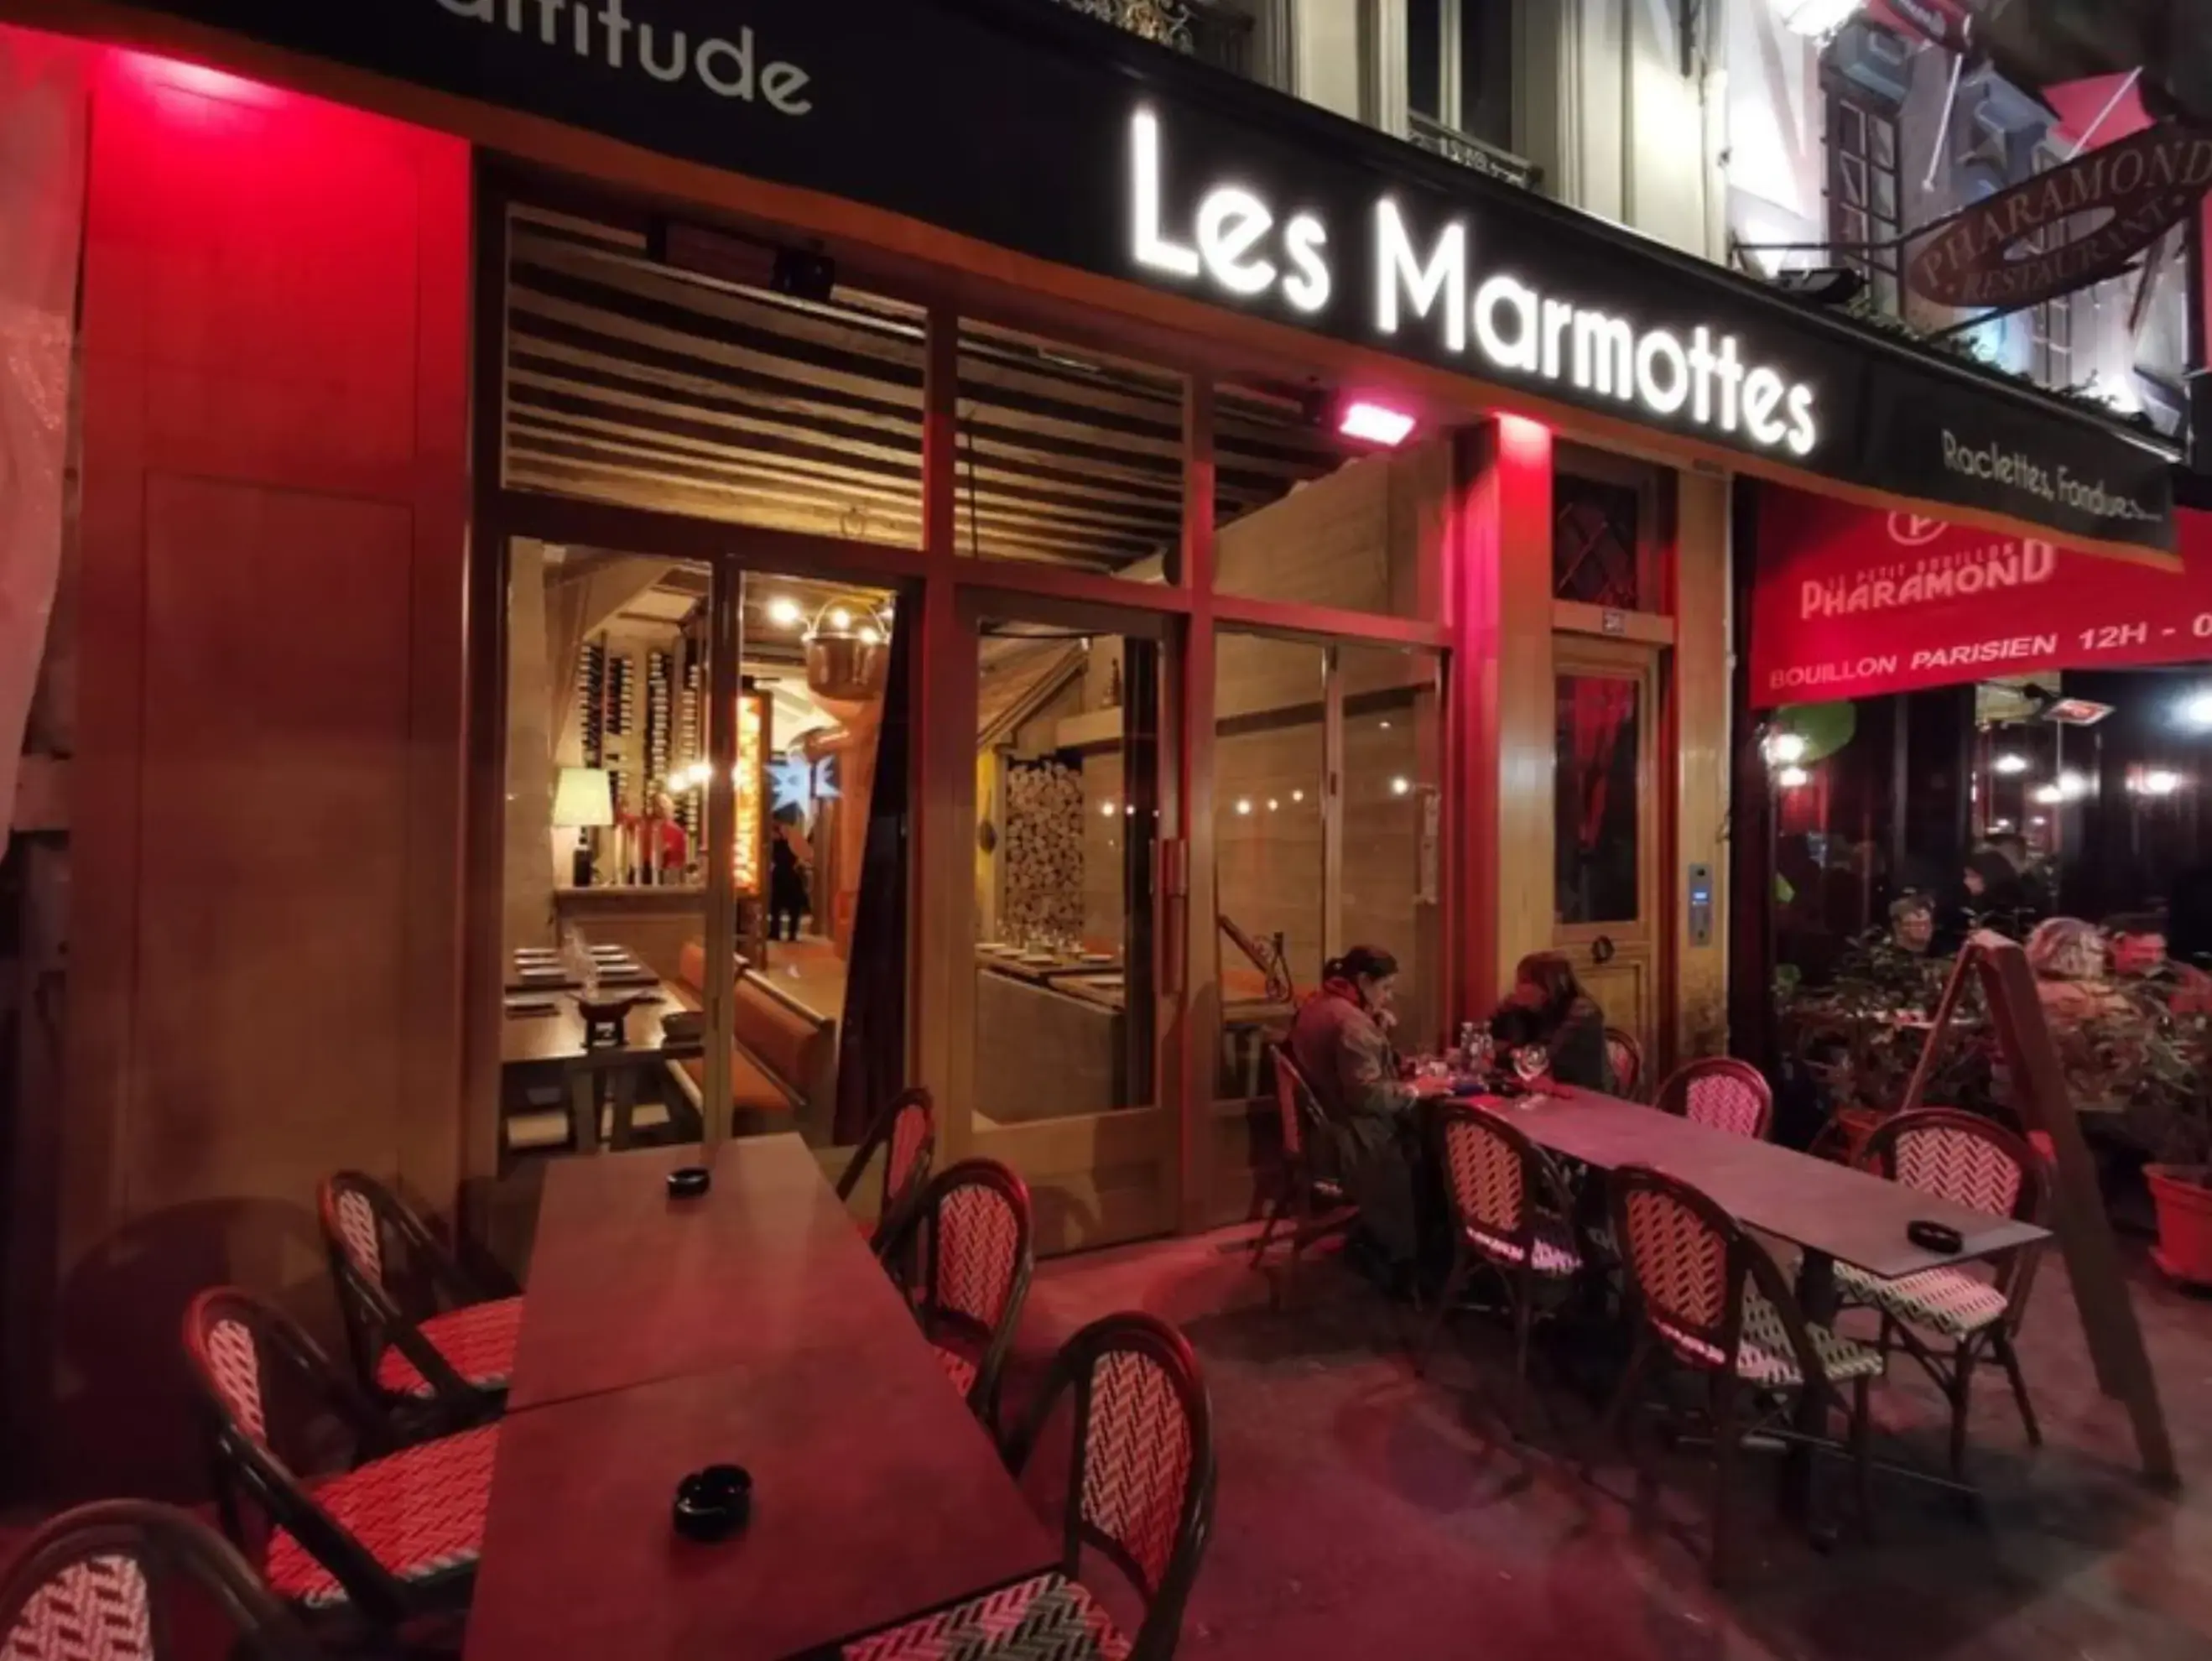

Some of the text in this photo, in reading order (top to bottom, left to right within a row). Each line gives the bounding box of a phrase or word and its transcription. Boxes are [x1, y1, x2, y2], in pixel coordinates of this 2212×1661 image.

[1921, 139, 2212, 288] PHARAMOND
[1132, 108, 1818, 457] Les Marmottes
[1941, 428, 2054, 502] Raclettes,
[1801, 539, 2055, 618] PHARAMOND
[1768, 655, 1897, 690] BOUILLON
[1910, 633, 2058, 669] PARISIEN
[2079, 621, 2147, 650] 12H
